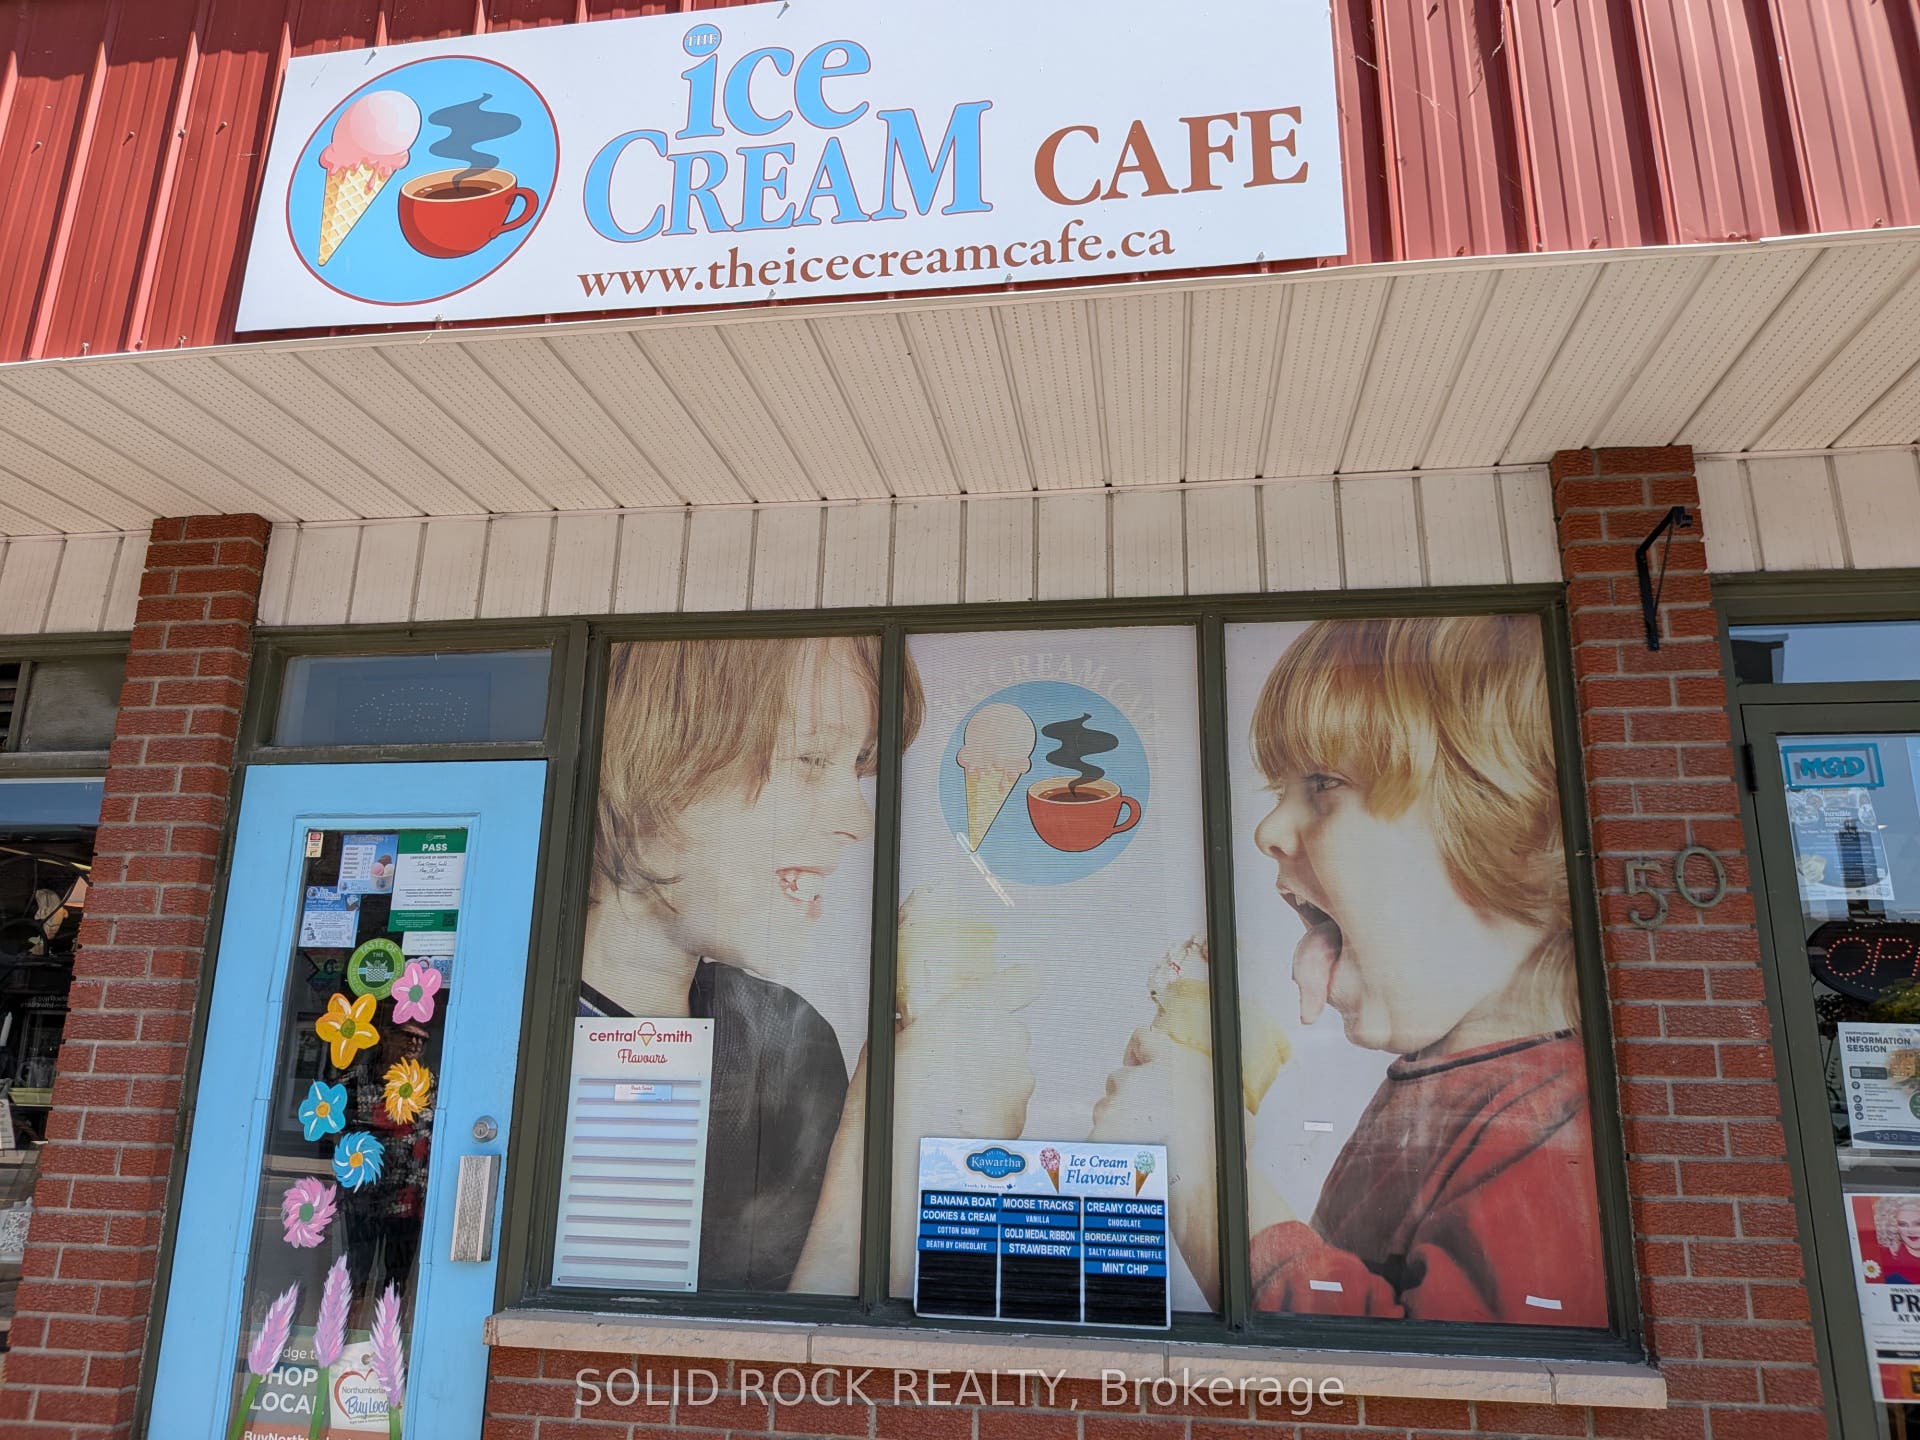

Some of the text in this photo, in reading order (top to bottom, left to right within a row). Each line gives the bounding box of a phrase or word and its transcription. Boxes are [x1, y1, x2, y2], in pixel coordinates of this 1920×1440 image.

[687, 33, 718, 47] THE
[676, 24, 870, 140] ice
[583, 100, 1309, 243] CREAM CAFE
[577, 220, 1176, 299] www.theicecreamcafe.ca
[1800, 756, 1865, 777] MGD
[422, 843, 448, 852] PASS
[1626, 846, 1727, 930] 50
[361, 940, 399, 954] TASTE OF
[589, 1030, 692, 1043] central smith
[1845, 1035, 1911, 1046] INFORMATION
[1847, 1044, 1887, 1053] SESSION
[617, 1048, 668, 1064] Flavours
[971, 1156, 1022, 1169] Kawartha
[1070, 1154, 1128, 1169] Ice Cream
[1065, 1169, 1132, 1186] Flavours!
[930, 1195, 997, 1207] BANANA BOAT
[1003, 1198, 1074, 1211] MOOSE TRACKS
[1086, 1202, 1163, 1215] CREAMY ORANGE
[922, 1210, 997, 1223] COOKIES & CREAM
[1025, 1215, 1050, 1224] VANILLA
[1107, 1218, 1141, 1228] CHOCOLATE
[937, 1225, 980, 1236] COTTON CANDY
[1005, 1228, 1076, 1241] GOLD MEDAL RIBBON
[1084, 1232, 1160, 1244] BORDEAUX CHERRY
[926, 1240, 987, 1251] DEATH BY CHOCOLATE
[1008, 1243, 1072, 1256] STRAWBERRY
[1088, 1247, 1162, 1260] SALTY CARAMEL TRUFFLE
[1102, 1262, 1149, 1275] MINT CHIP
[278, 1347, 307, 1361] dge
[345, 1395, 389, 1419] Buy Loca
